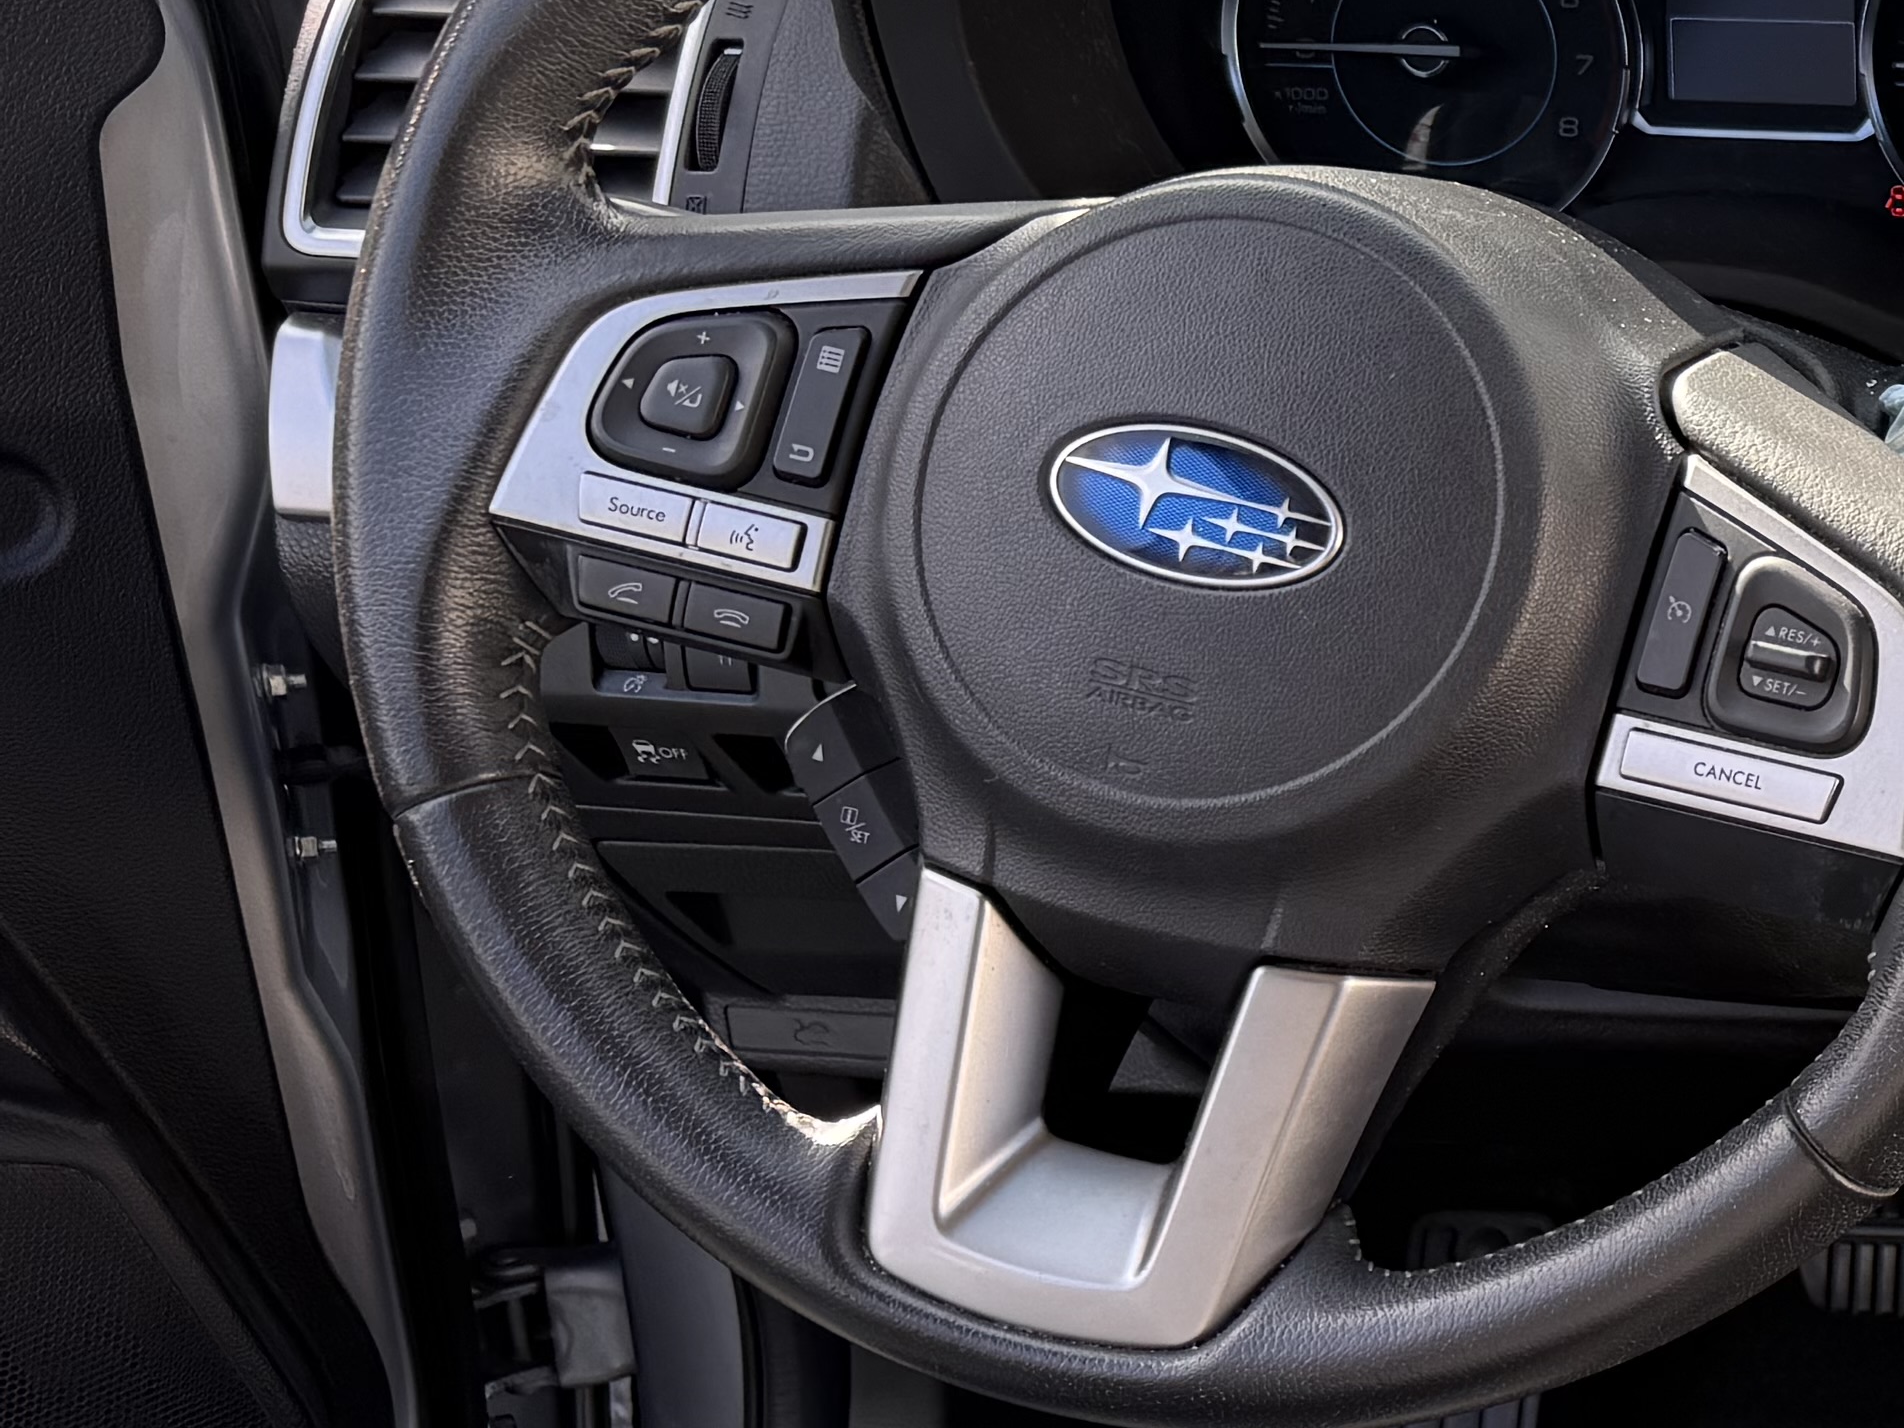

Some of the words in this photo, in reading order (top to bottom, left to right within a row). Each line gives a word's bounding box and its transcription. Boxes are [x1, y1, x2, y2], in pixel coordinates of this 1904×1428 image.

[1575, 55, 1595, 76] 7
[1558, 117, 1580, 137] 8
[607, 495, 667, 525] Source
[1089, 656, 1198, 704] SRS
[1085, 686, 1196, 725] AIRBAG
[658, 746, 689, 762] OFF
[1692, 761, 1763, 791] CANCEL
